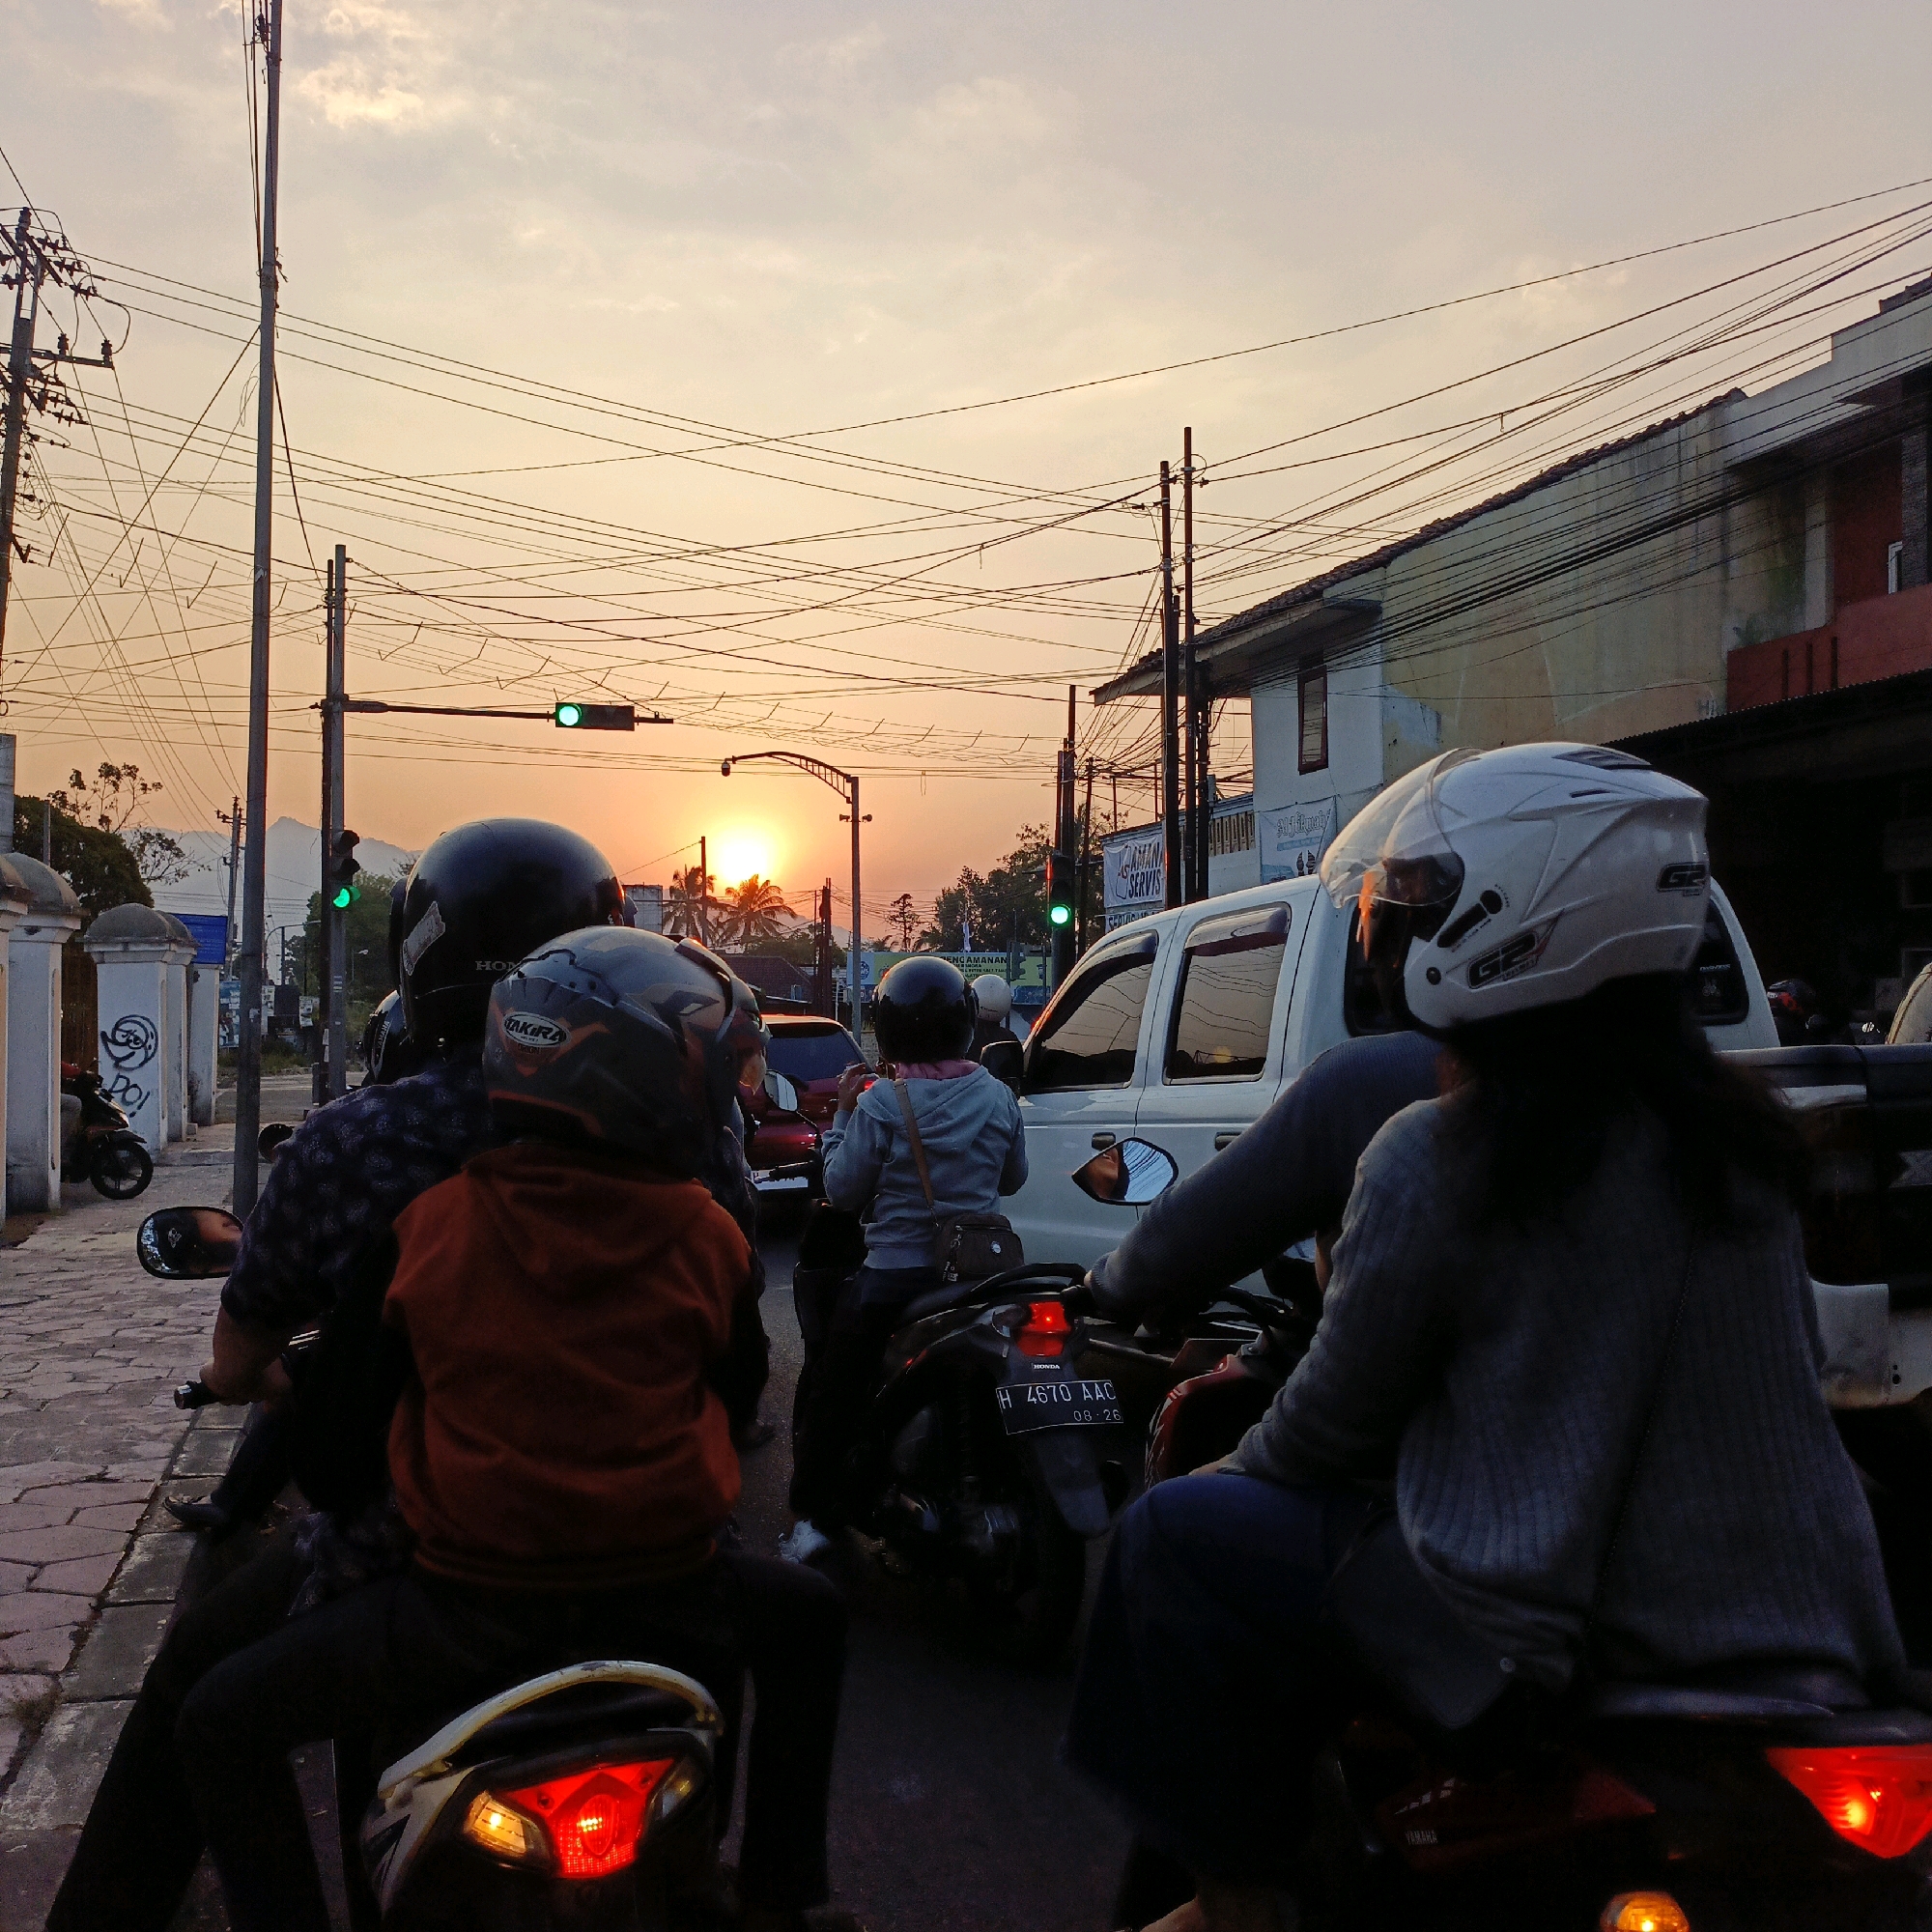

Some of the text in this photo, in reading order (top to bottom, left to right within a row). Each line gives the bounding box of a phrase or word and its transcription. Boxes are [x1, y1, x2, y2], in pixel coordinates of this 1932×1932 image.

[1128, 869, 1162, 898] SERVIS
[504, 1018, 567, 1042] TAKIRA
[998, 1382, 1117, 1409] H 4670 AAC
[1405, 1829, 1438, 1846] YAMAHA
